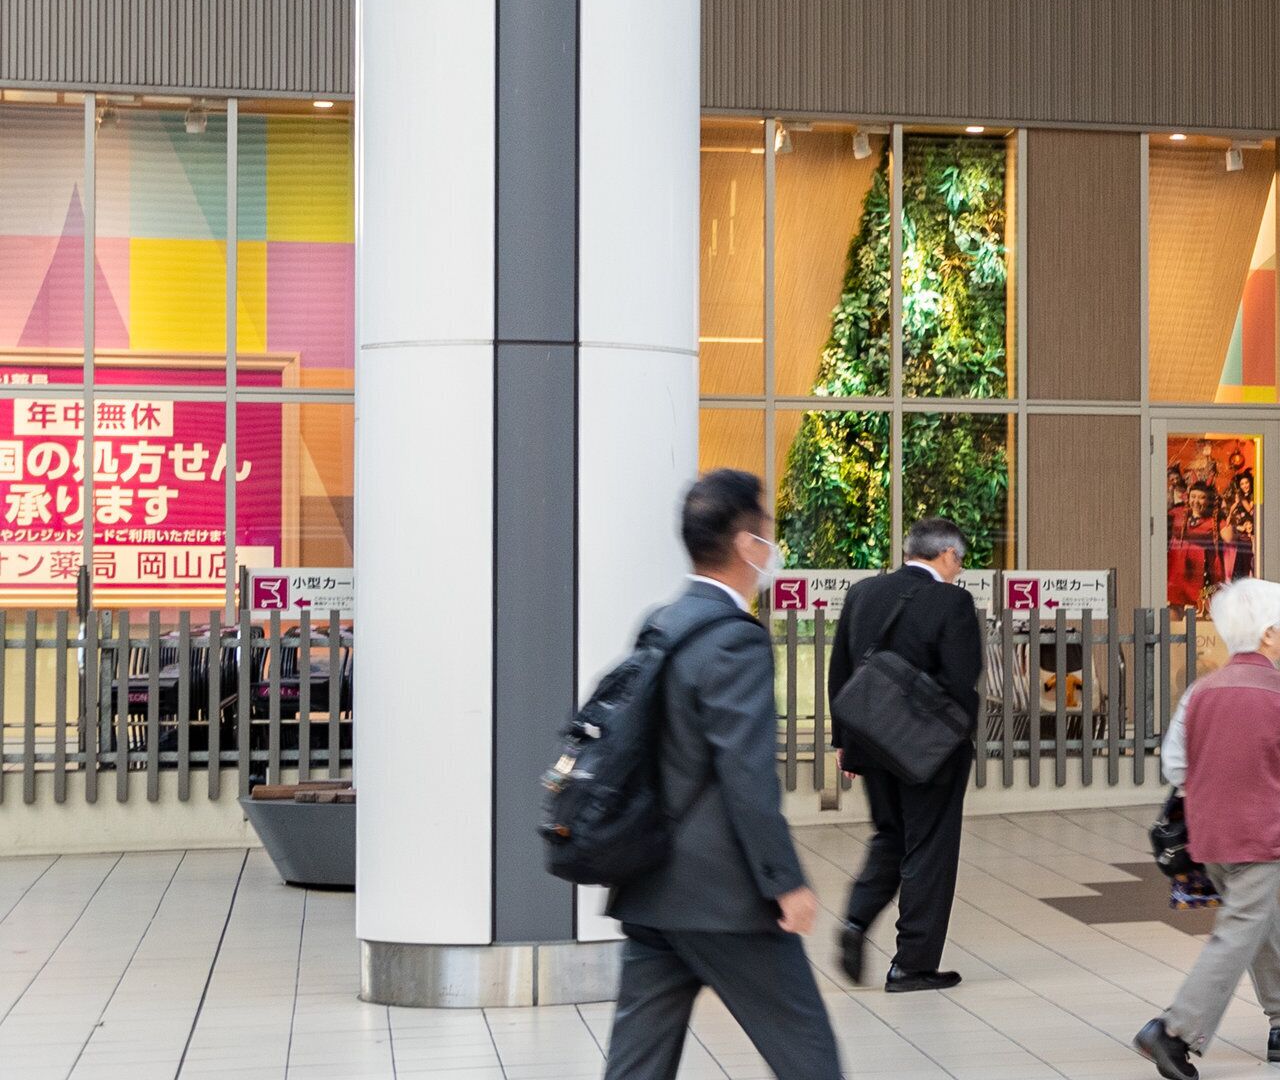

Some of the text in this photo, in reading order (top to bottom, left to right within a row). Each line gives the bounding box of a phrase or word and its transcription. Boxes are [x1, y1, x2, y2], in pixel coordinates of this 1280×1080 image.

[27, 401, 162, 430] 年中無休
[5, 483, 179, 526] 承ります
[0, 528, 228, 544] やクレジットカードご利用いただけま
[810, 578, 851, 591] 小型カ
[955, 578, 991, 591] カート
[1042, 578, 1105, 592] 小型カート
